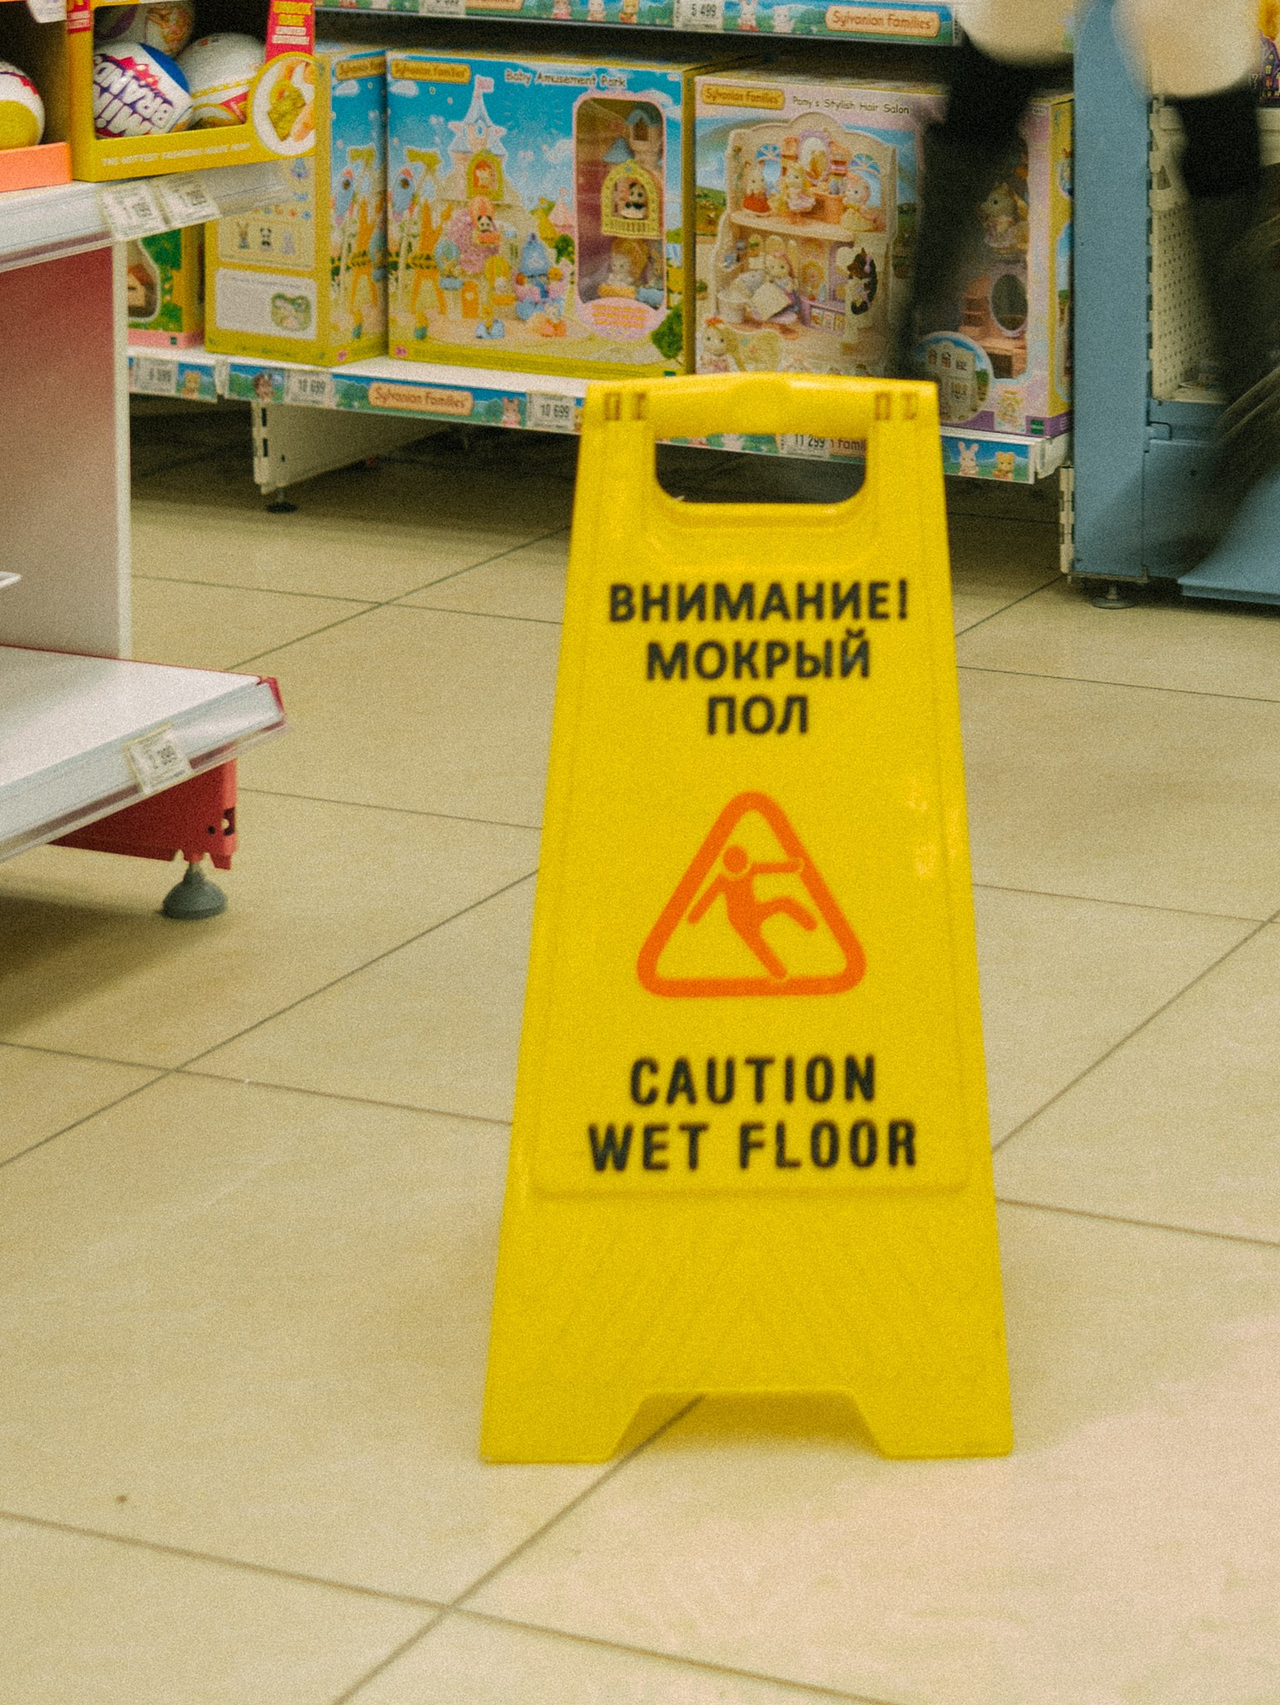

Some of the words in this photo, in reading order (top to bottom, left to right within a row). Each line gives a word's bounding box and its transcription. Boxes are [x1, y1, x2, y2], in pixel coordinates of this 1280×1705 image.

[831, 10, 885, 29] Sylvanian
[887, 12, 931, 30] Families
[505, 69, 531, 86] Baby
[536, 72, 596, 85] Amusement
[600, 74, 626, 87] Park
[704, 88, 745, 103] Sylvanian
[747, 91, 780, 105] Families
[824, 98, 854, 111] Stylish
[860, 101, 880, 112] Hair
[883, 103, 910, 115] Salon
[374, 386, 422, 404] Sylvanian
[423, 391, 467, 408] Families
[608, 579, 909, 624] ВНИМАНИЕ!
[645, 629, 871, 681] МОКРЫЙ
[705, 695, 809, 736] ПОЛ
[629, 1054, 877, 1107] CAUTION
[587, 1122, 709, 1172] WET
[739, 1119, 918, 1170] FLOOR
